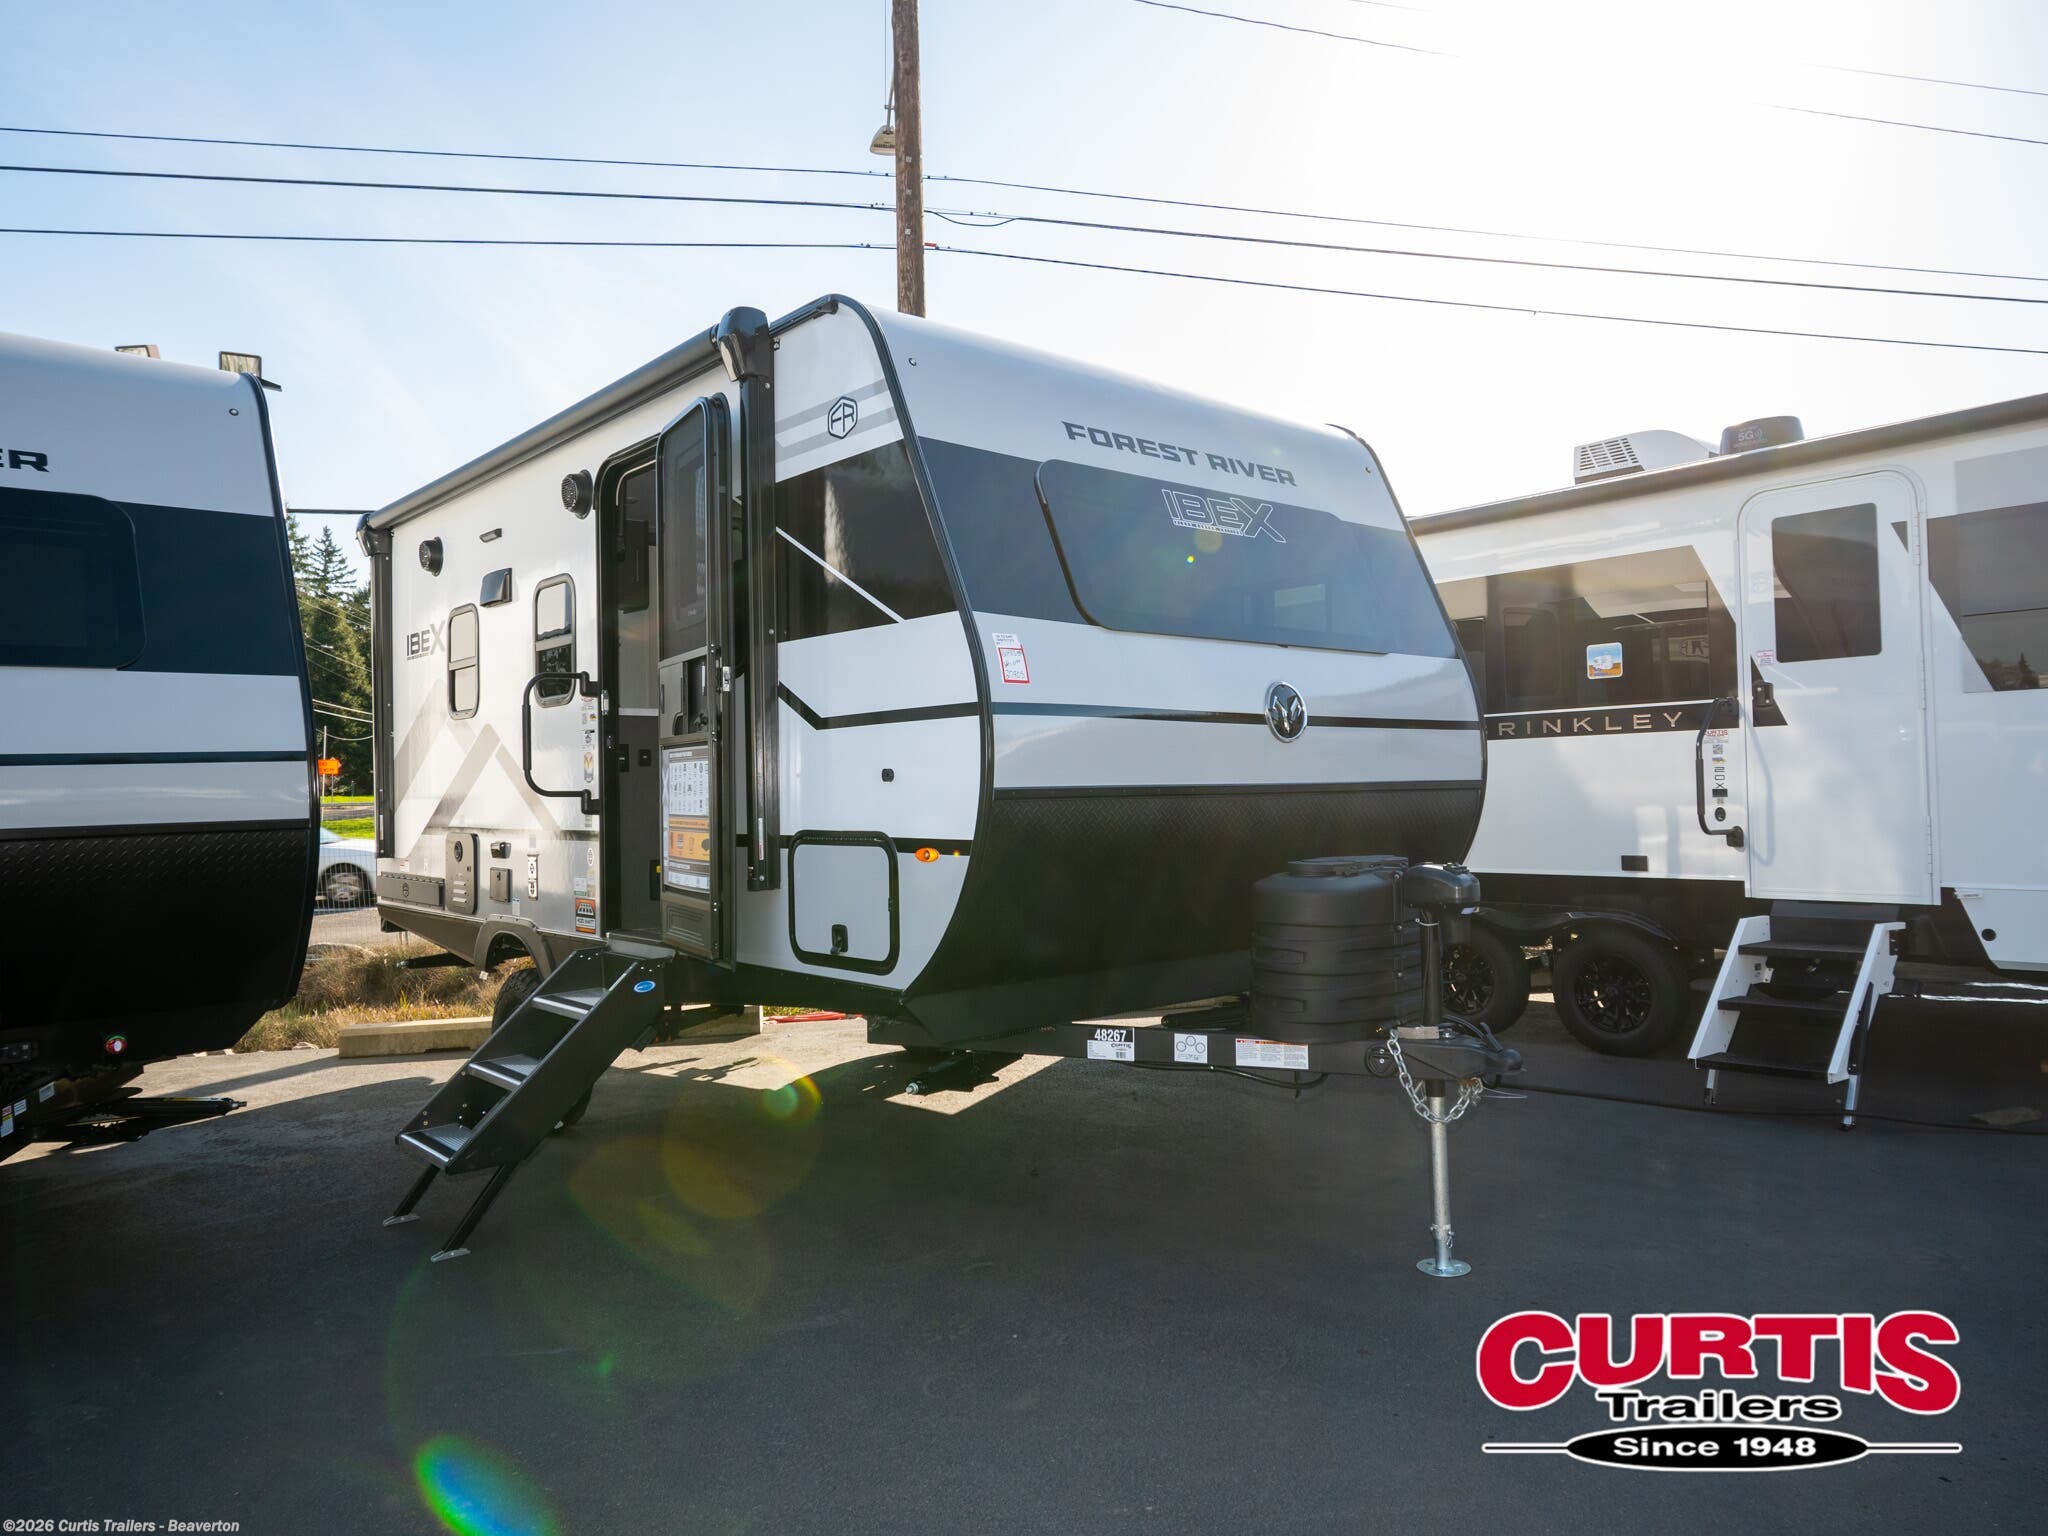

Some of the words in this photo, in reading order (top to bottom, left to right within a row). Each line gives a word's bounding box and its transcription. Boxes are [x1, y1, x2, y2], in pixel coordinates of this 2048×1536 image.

[1062, 421, 1198, 465] FOREST
[1205, 453, 1297, 487] RIVER
[1161, 489, 1287, 543] IBEX
[406, 619, 446, 657] IBEX
[1094, 1028, 1127, 1042] 48267
